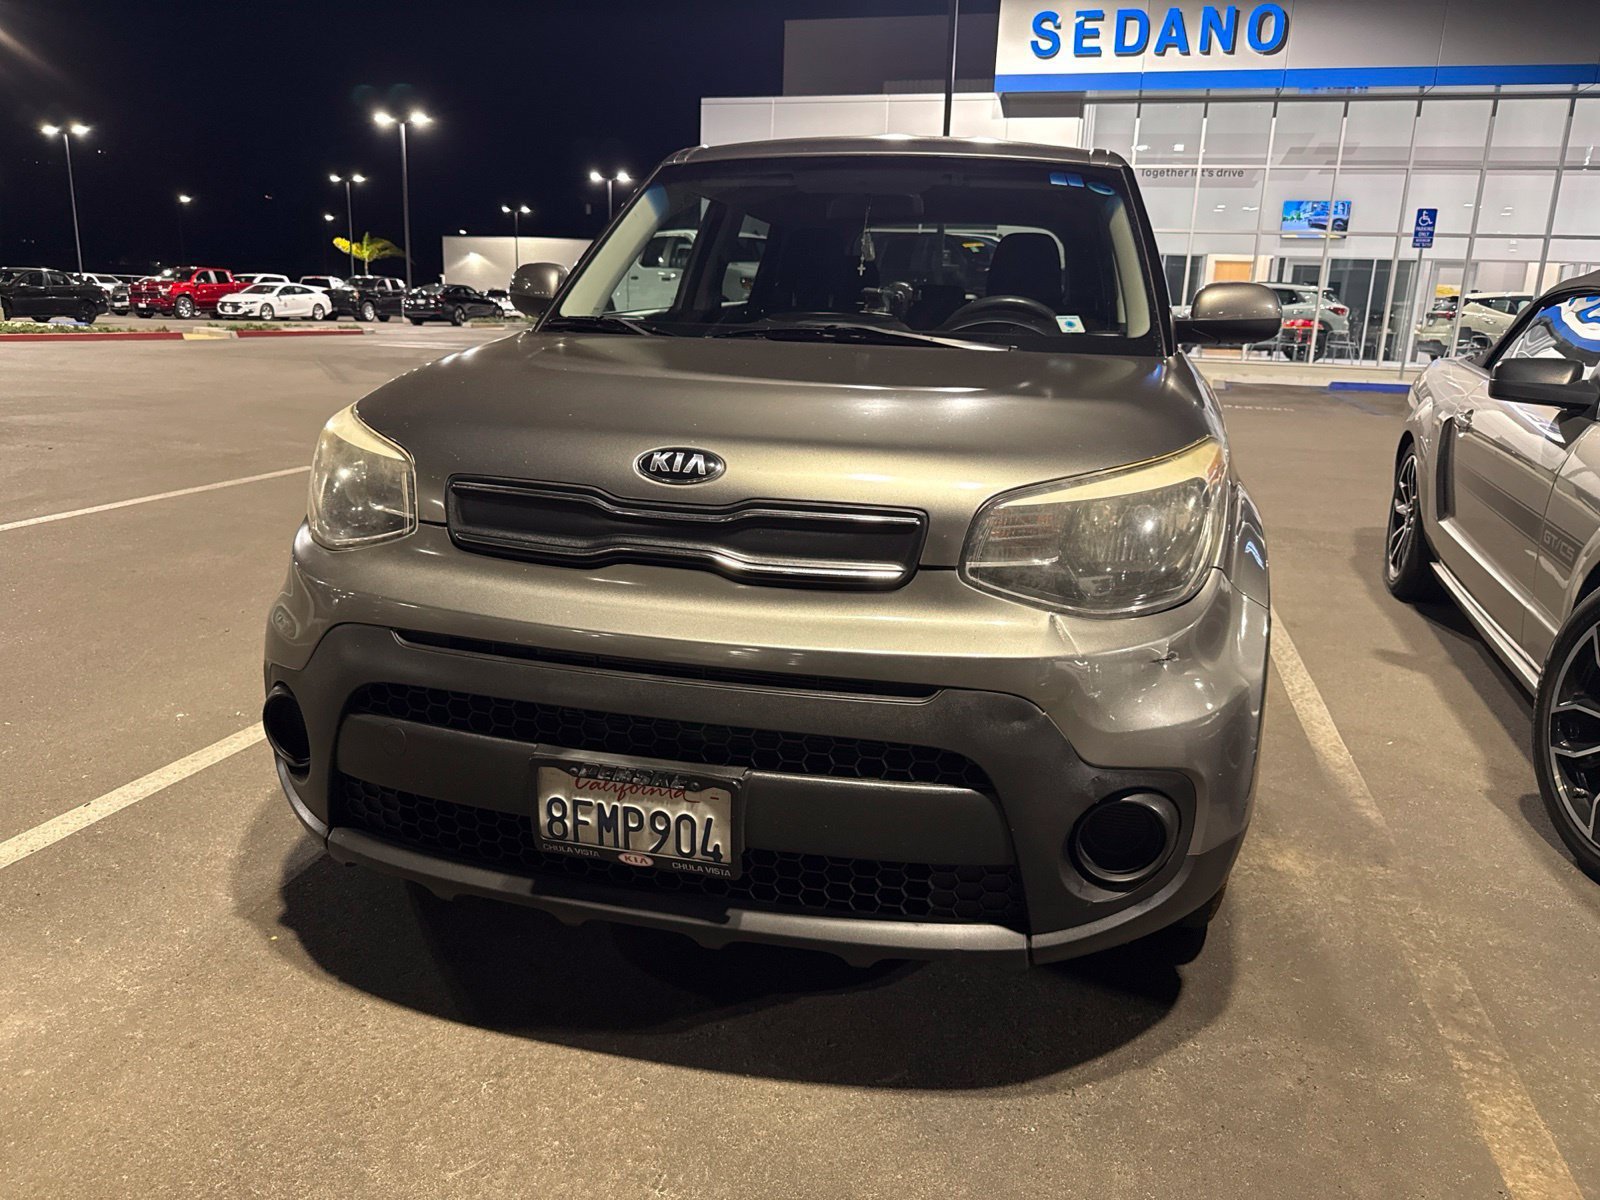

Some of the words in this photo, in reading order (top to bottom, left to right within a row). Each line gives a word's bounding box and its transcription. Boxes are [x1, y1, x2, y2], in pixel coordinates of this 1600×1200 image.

[1030, 3, 1289, 60] SEDANO
[1140, 168, 1190, 179] Together
[1216, 168, 1245, 178] drive
[649, 451, 707, 476] KIA
[574, 777, 701, 804] California
[546, 796, 724, 863] 8FMP904
[542, 843, 574, 854] CHULA
[574, 847, 600, 858] VISTA
[624, 855, 649, 865] KIA
[671, 861, 704, 873] CHULA
[704, 866, 732, 877] VISTA
